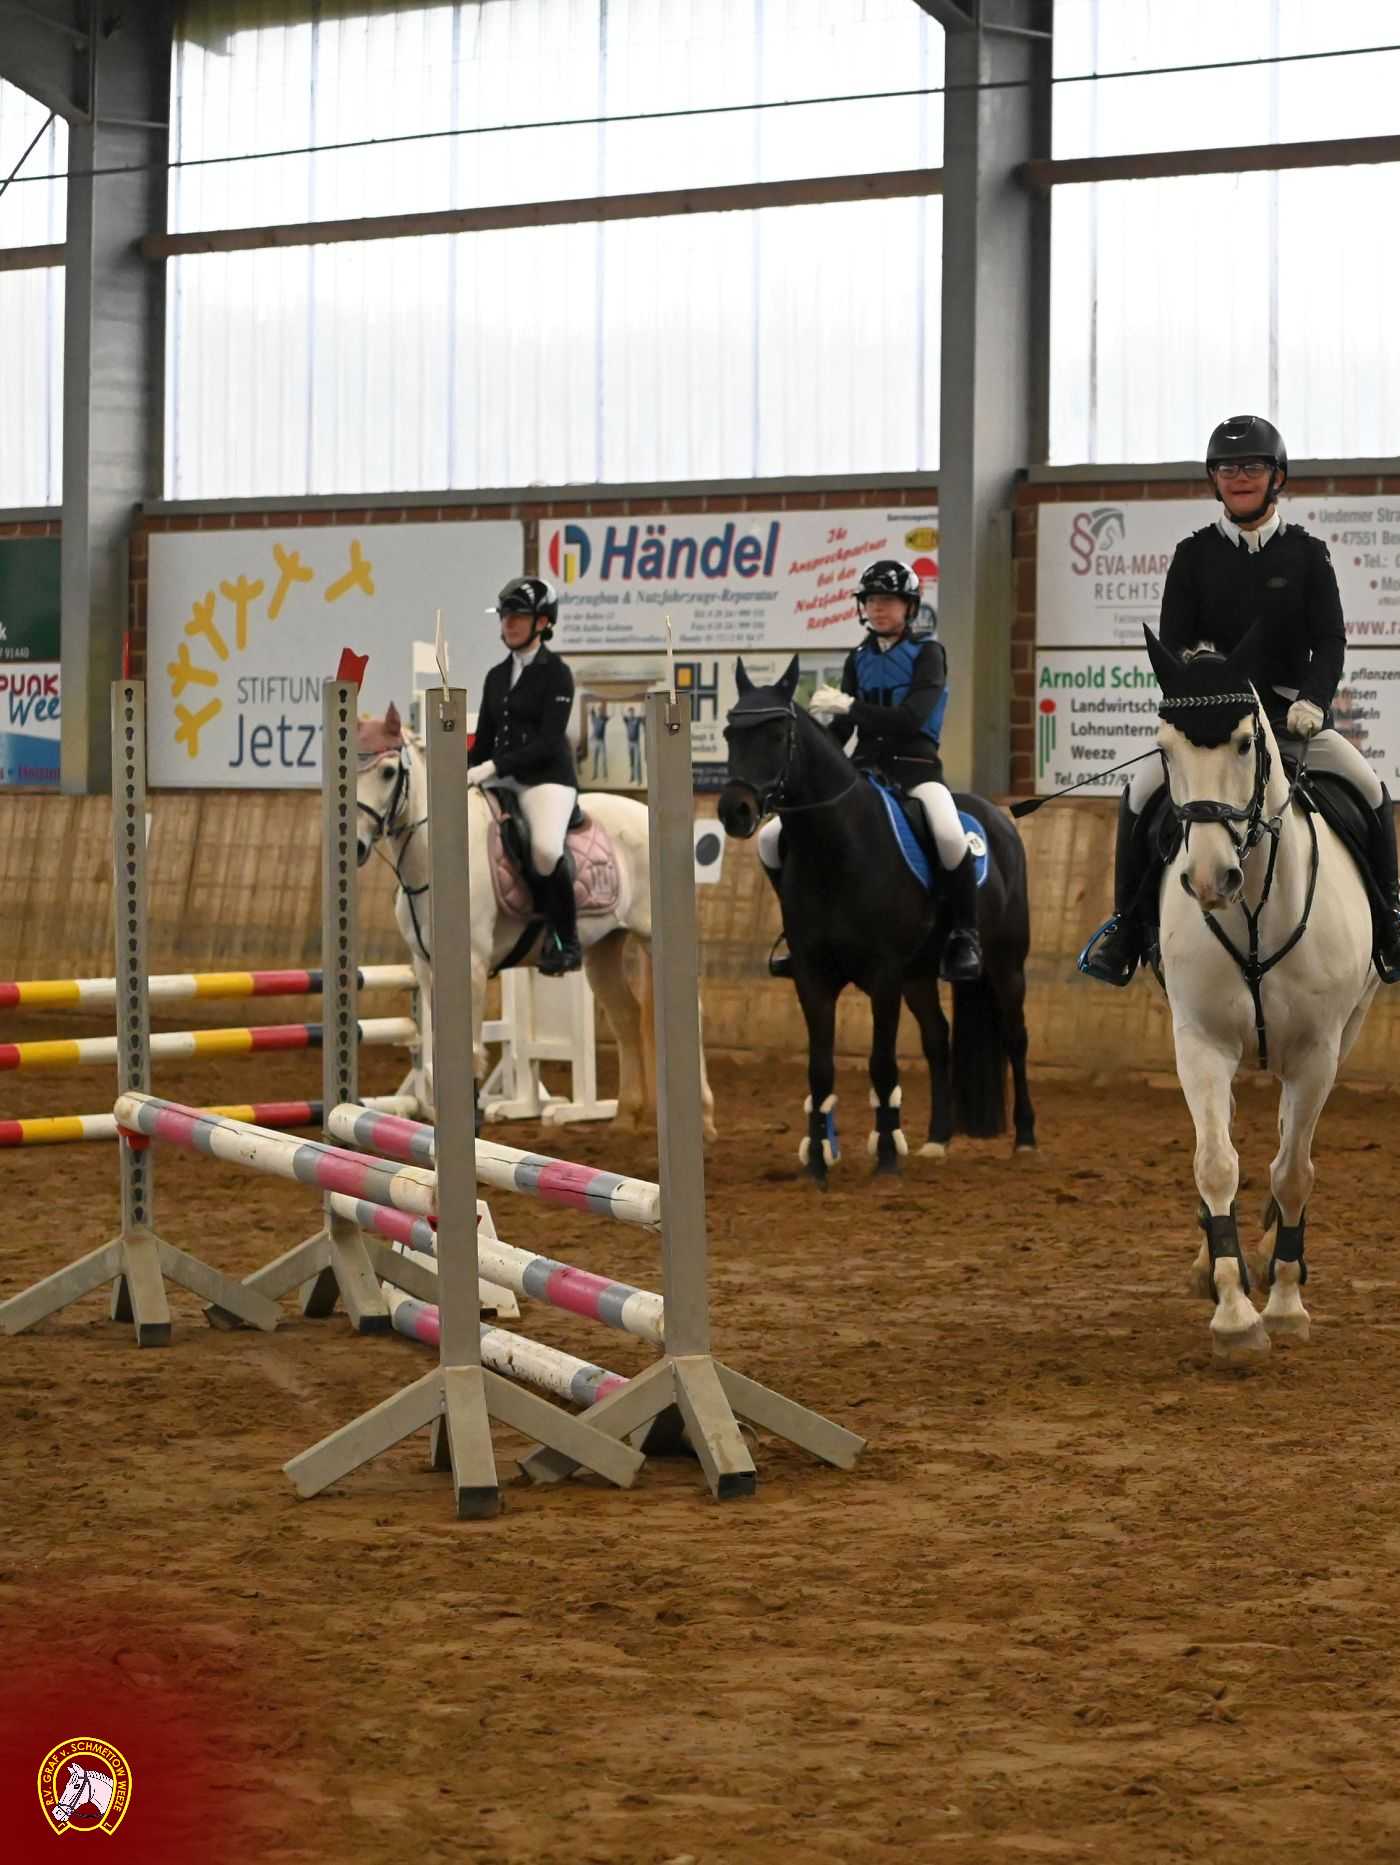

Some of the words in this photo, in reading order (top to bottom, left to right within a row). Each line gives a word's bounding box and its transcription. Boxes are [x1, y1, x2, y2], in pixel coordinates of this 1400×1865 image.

[600, 520, 780, 581] Händel
[1095, 554, 1174, 576] EVA-MAR
[1039, 665, 1105, 688] Arnold
[229, 712, 323, 768] Jetz
[1071, 745, 1117, 760] Weeze
